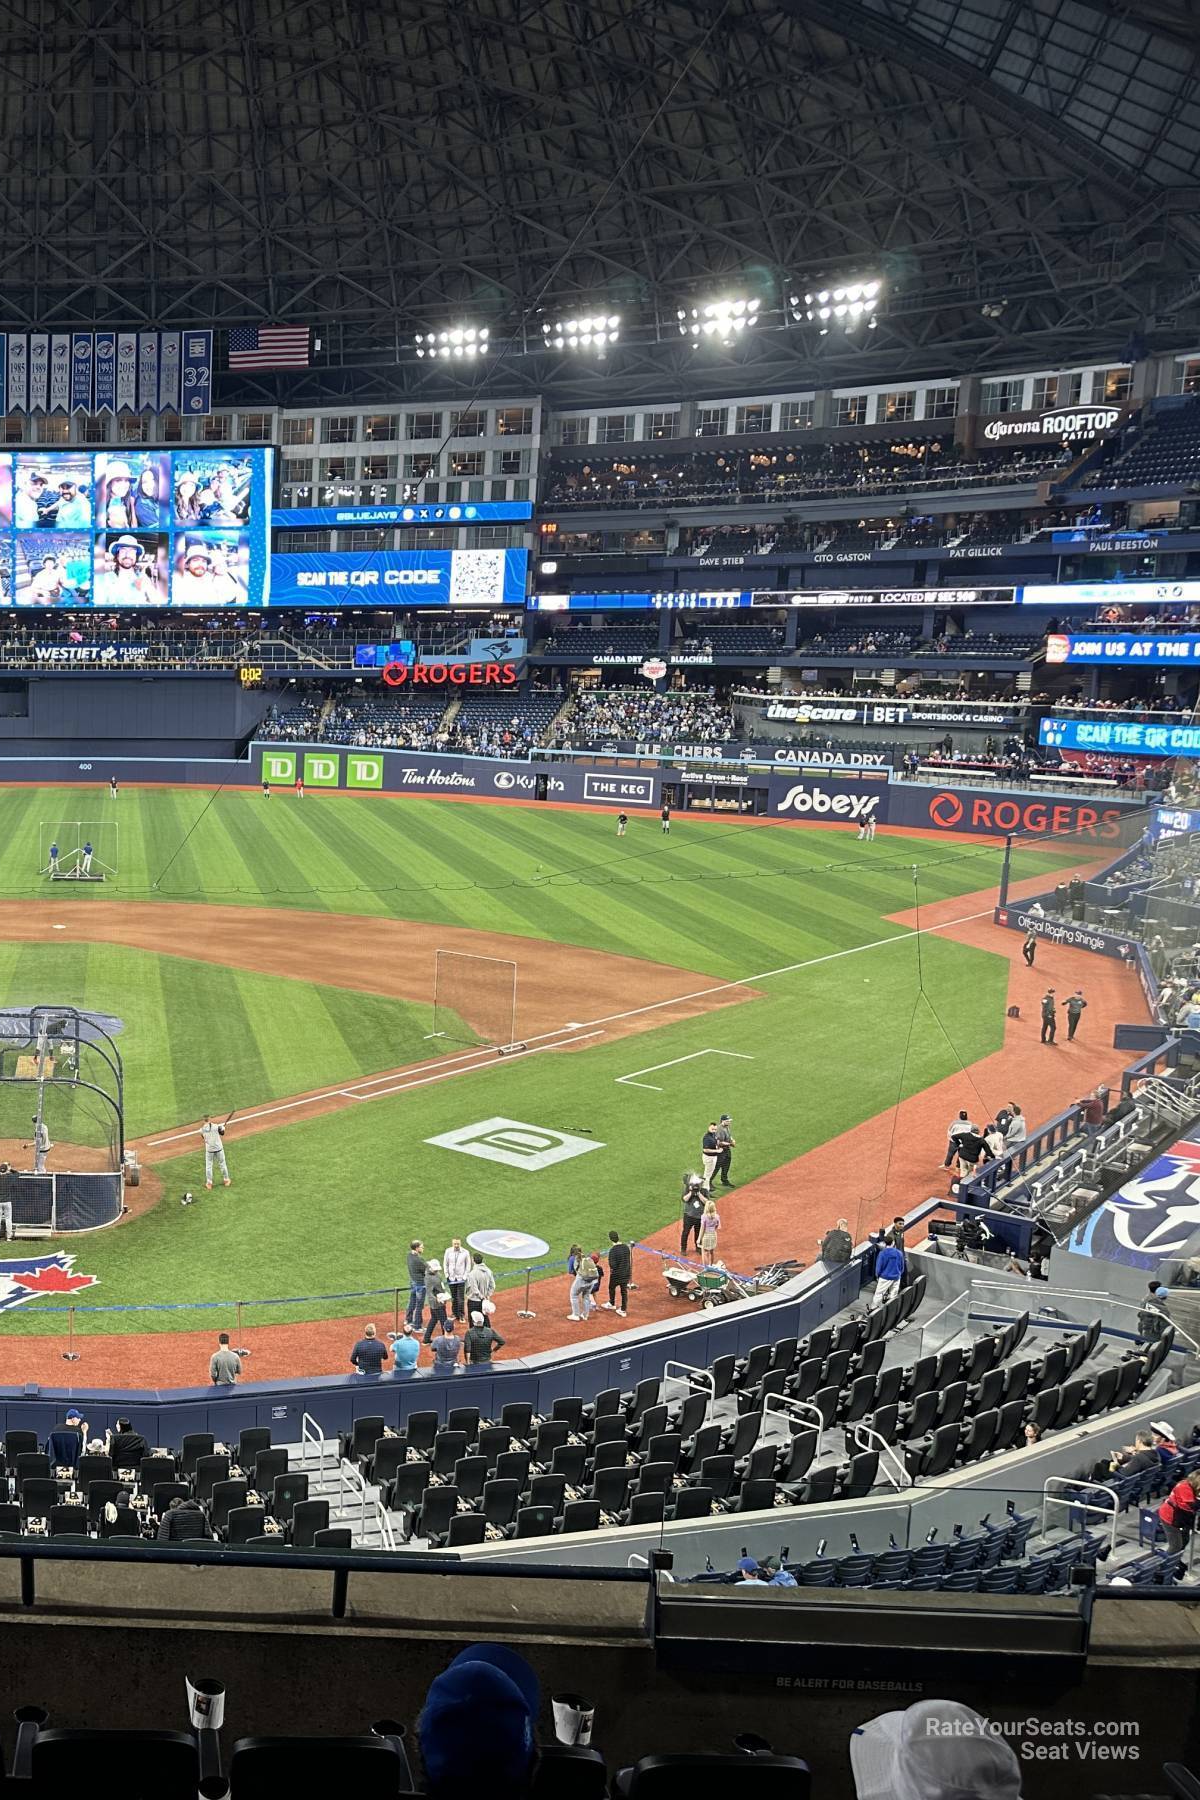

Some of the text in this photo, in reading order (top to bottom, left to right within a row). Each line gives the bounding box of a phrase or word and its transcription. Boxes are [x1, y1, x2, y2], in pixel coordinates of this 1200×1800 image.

[10, 362, 25, 374] 1985
[31, 362, 46, 374] 1989
[53, 362, 68, 374] 1991
[75, 362, 90, 374] 1992
[98, 362, 113, 374] 1993
[119, 362, 135, 373] 2015
[141, 362, 156, 372] 2016
[184, 366, 210, 387] 32
[10, 385, 25, 393] EAST
[31, 385, 45, 393] EAST
[52, 385, 67, 393] EAST
[984, 412, 1119, 440] Corona ROOFTOP
[1062, 430, 1095, 441] PATIO
[336, 511, 398, 521] @BLUEJAYS
[1089, 539, 1159, 552] PAUL BEESTON
[813, 552, 871, 563] CITO GASTON
[950, 547, 1002, 558] PAT GILLICK
[699, 557, 745, 566] DAVE STIEB
[296, 569, 441, 588] SCAN THE QR CODE
[880, 592, 923, 603] LOCATED
[35, 647, 149, 660] WESTJET FLIGHT
[1072, 642, 1101, 657] JOIN
[1105, 641, 1128, 657] US
[1129, 641, 1153, 657] AT
[1157, 642, 1190, 657] THE
[593, 655, 627, 663] CANADA
[670, 656, 713, 664] BLEACHERS
[240, 668, 262, 681] 0:02
[412, 663, 516, 684] ROGERS
[767, 703, 1004, 723] theScore BET SPORTSBOOK & CASINO
[1076, 724, 1110, 745] SCAN
[1113, 725, 1143, 745] THE
[1145, 728, 1169, 748] QR
[775, 749, 886, 766] CANADA DRY
[78, 763, 92, 771] 400
[266, 757, 293, 778] TD
[308, 759, 336, 780] TD
[351, 760, 379, 781] TD
[401, 768, 475, 787] Tim Hortons
[681, 772, 704, 780] Active
[592, 782, 645, 795] THE KEG
[777, 784, 880, 818] Sobeys
[972, 799, 1121, 840] ROGERS
[1173, 811, 1189, 831] 20
[1044, 922, 1105, 950] Roofing Shingle
[455, 1127, 565, 1157] TD
[776, 1676, 923, 1692] BE ALERT FOR BASEBALLS
